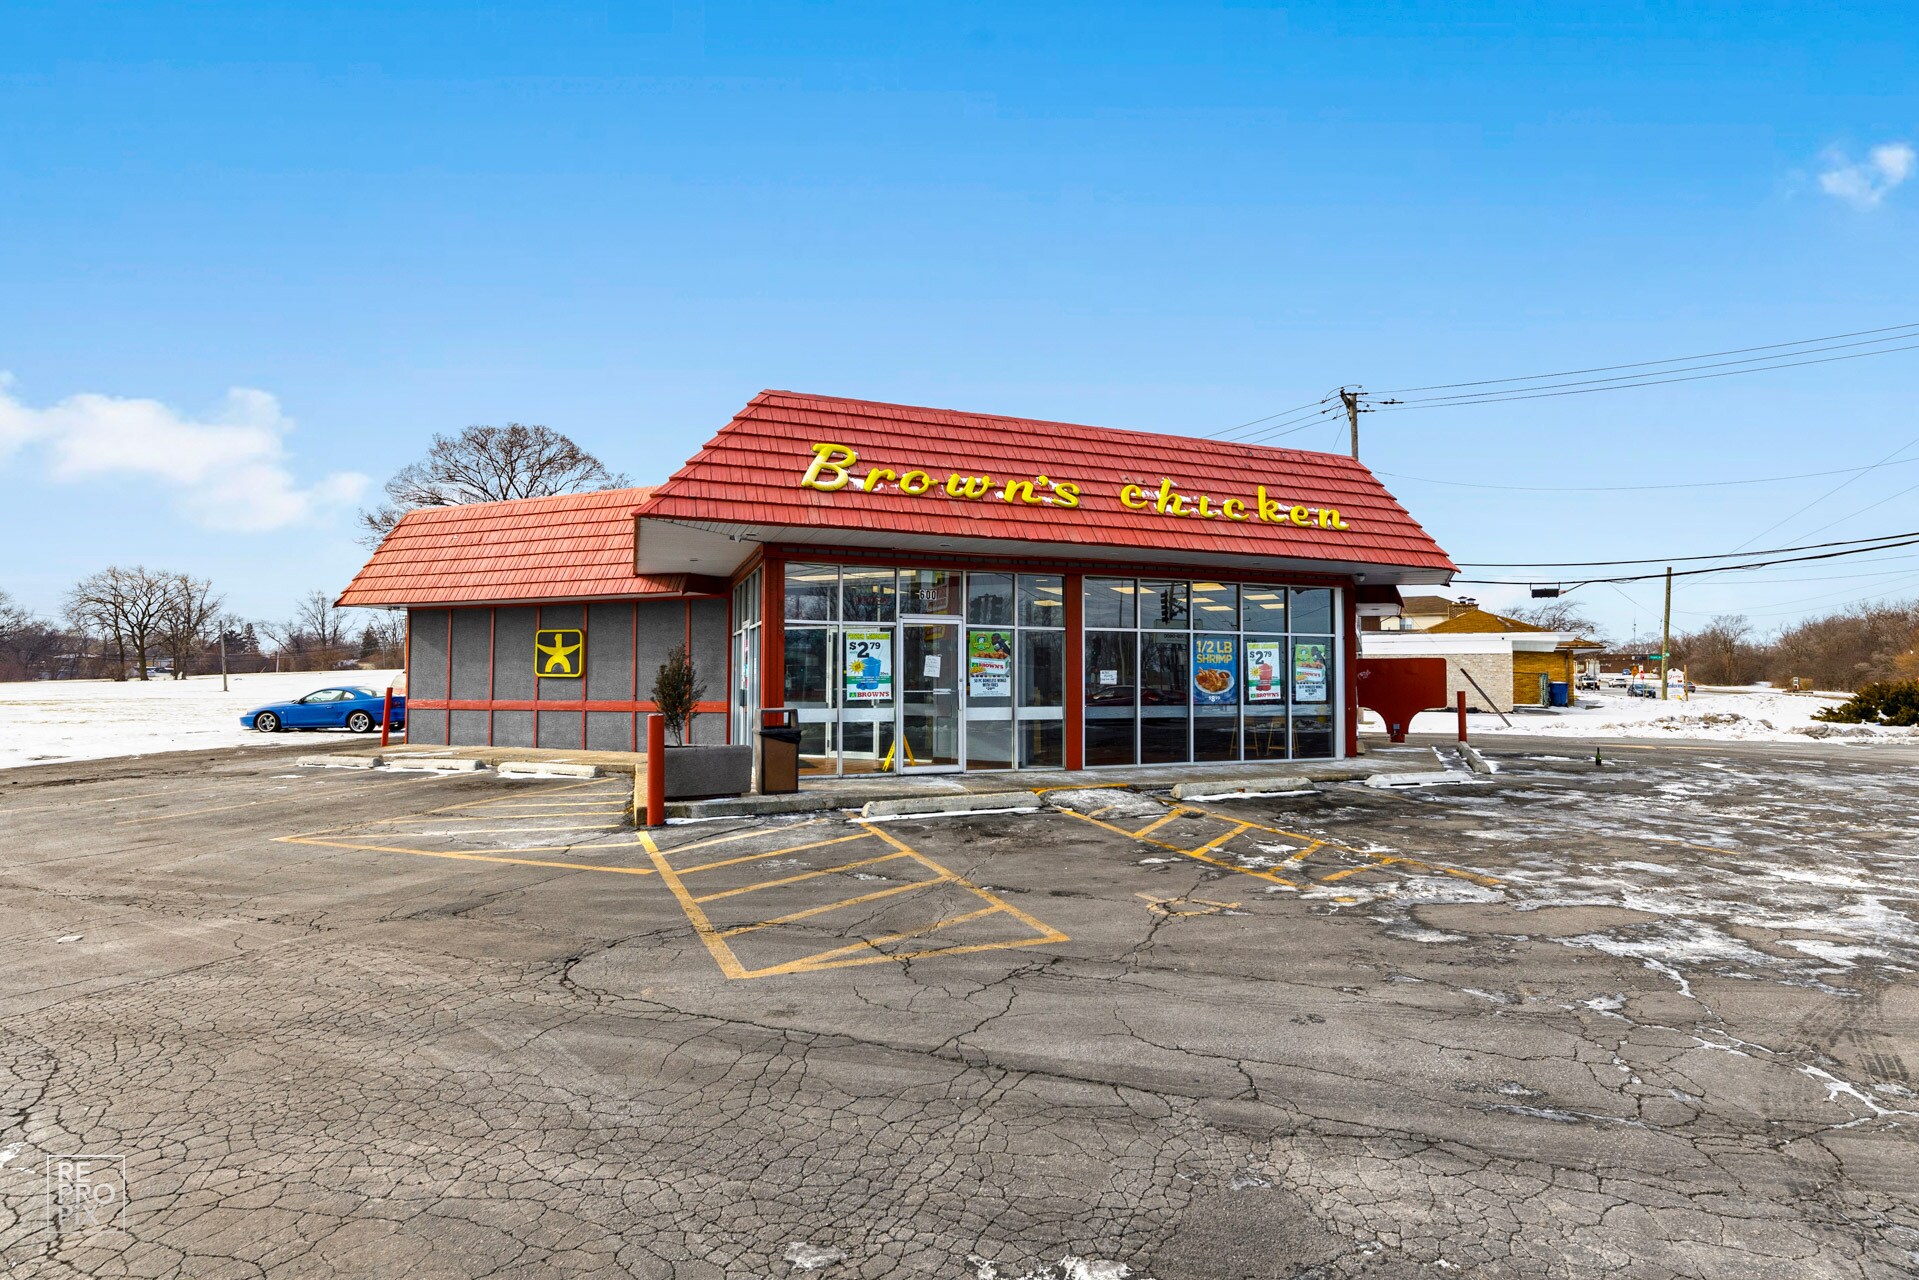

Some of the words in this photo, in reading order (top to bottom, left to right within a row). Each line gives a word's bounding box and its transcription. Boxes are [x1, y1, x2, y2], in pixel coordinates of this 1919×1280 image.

[801, 443, 1080, 508] Brown's
[1120, 478, 1350, 531] chicken
[919, 589, 937, 600] 600
[1196, 641, 1214, 653] 1/2
[1216, 641, 1233, 653] LB
[1196, 653, 1233, 664] SHRIMP
